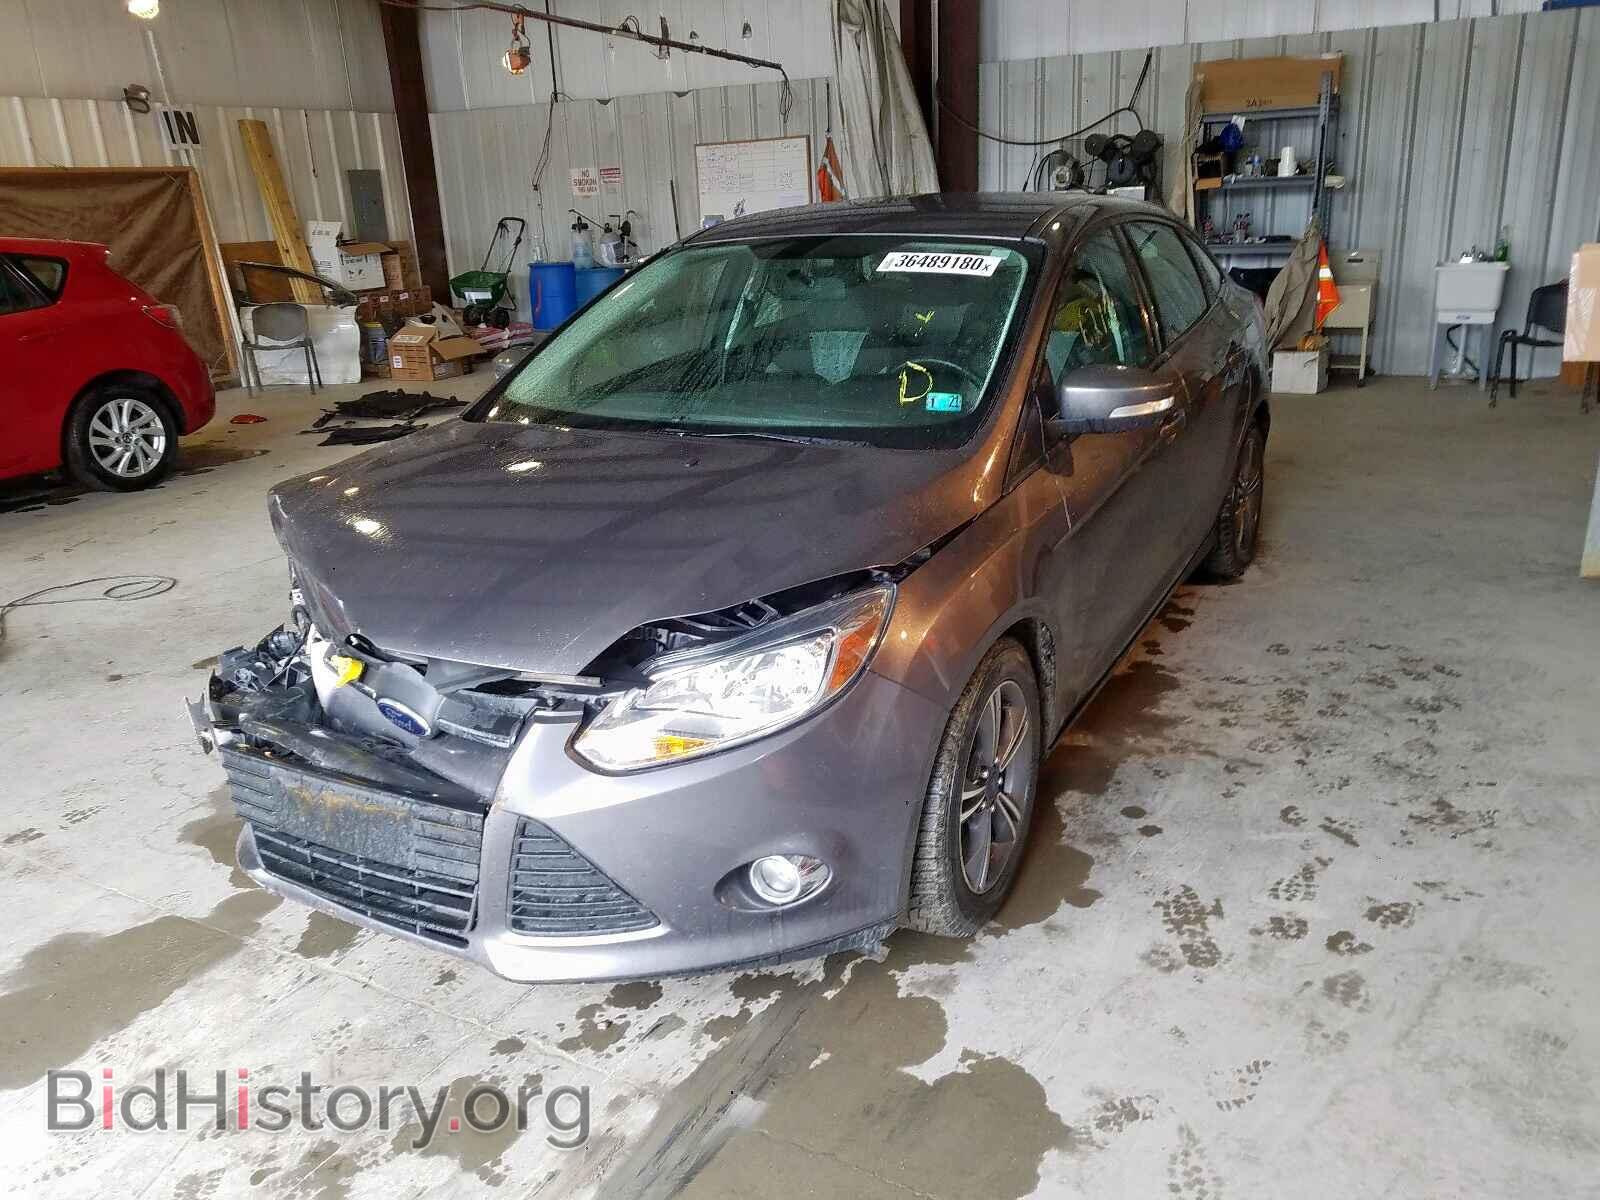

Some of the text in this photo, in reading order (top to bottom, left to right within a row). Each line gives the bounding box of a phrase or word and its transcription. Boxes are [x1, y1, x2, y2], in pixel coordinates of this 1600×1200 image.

[162, 110, 201, 145] IN
[581, 169, 590, 178] NO
[898, 360, 933, 406] D
